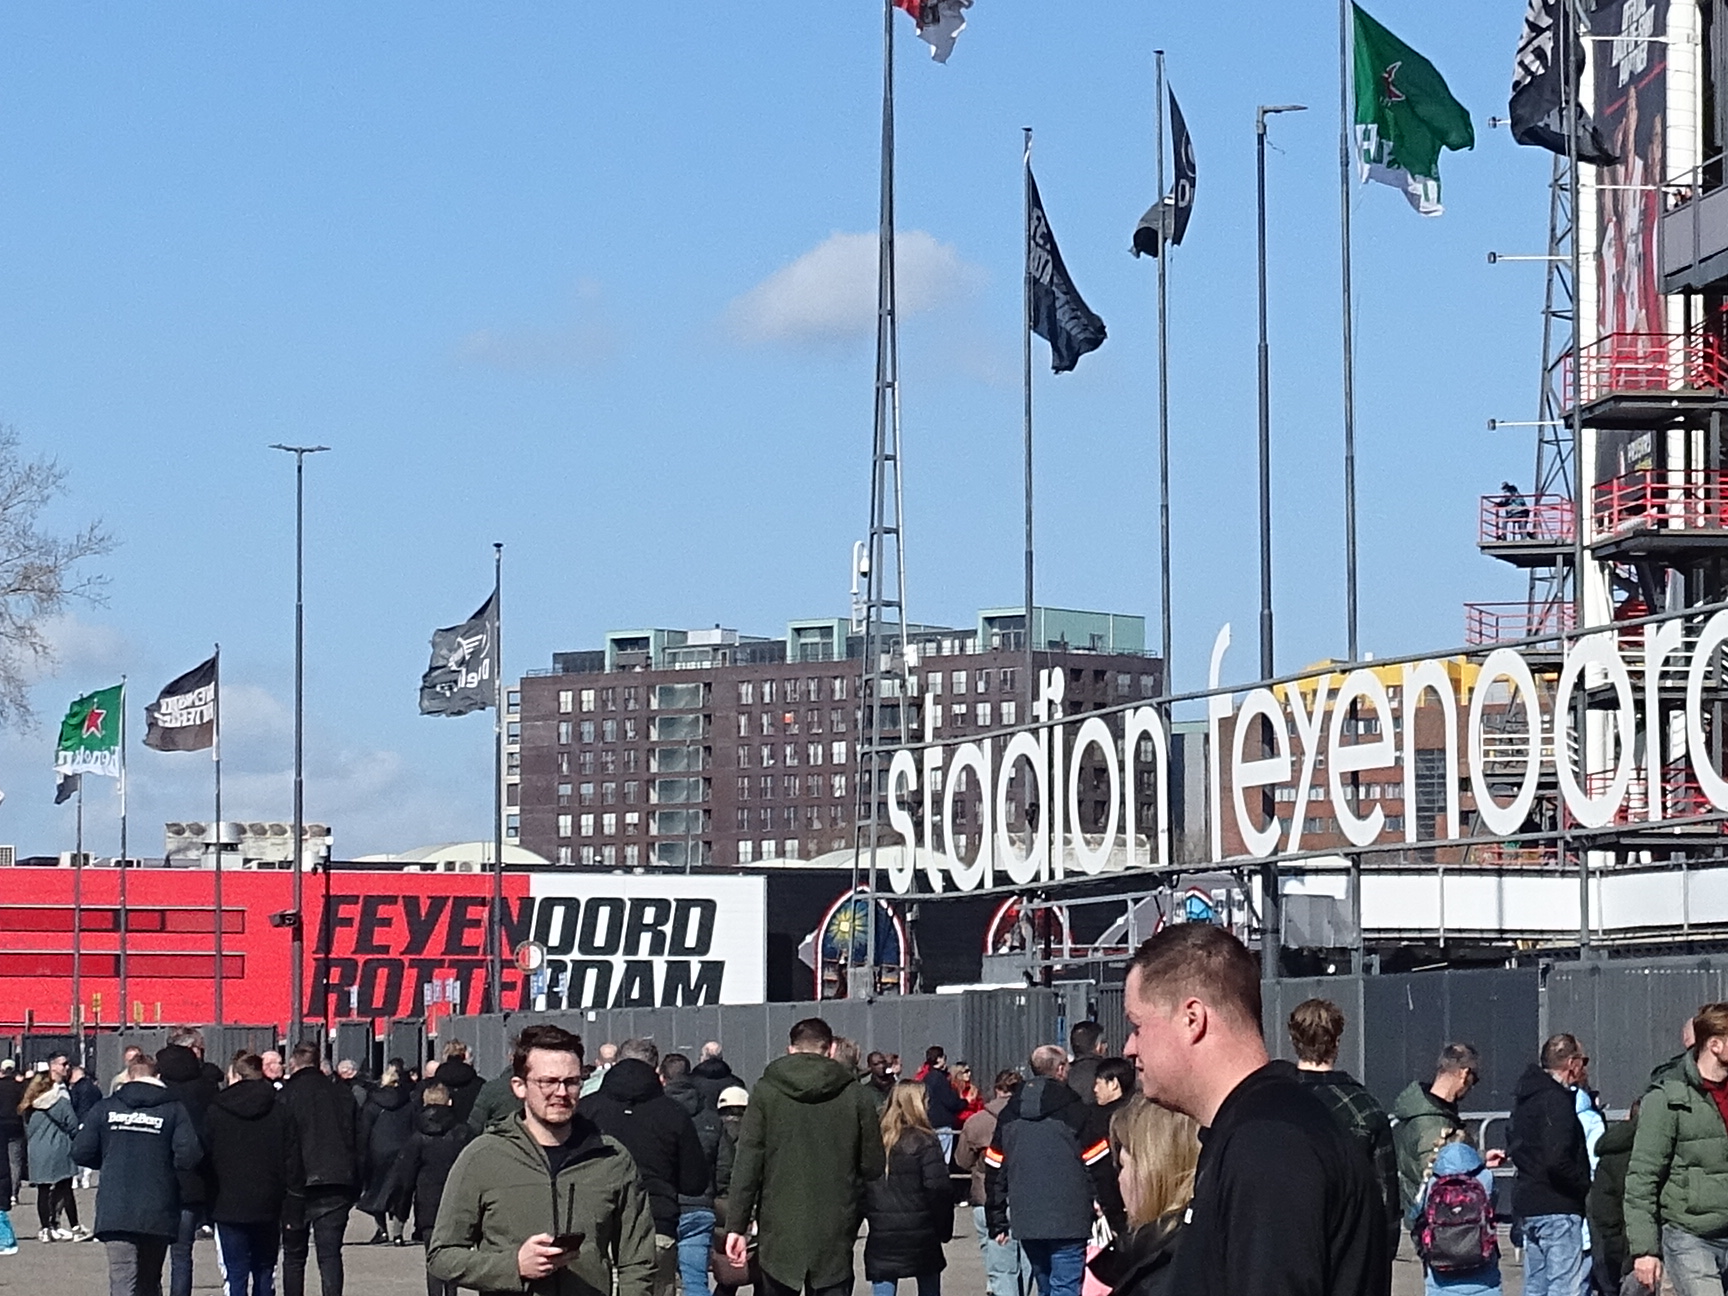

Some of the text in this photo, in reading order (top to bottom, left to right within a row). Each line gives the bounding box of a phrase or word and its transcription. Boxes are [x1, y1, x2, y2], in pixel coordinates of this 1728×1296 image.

[887, 665, 1169, 896] stadion
[313, 894, 718, 957] FEYENOORD
[306, 956, 727, 1018] ROTTERDAM
